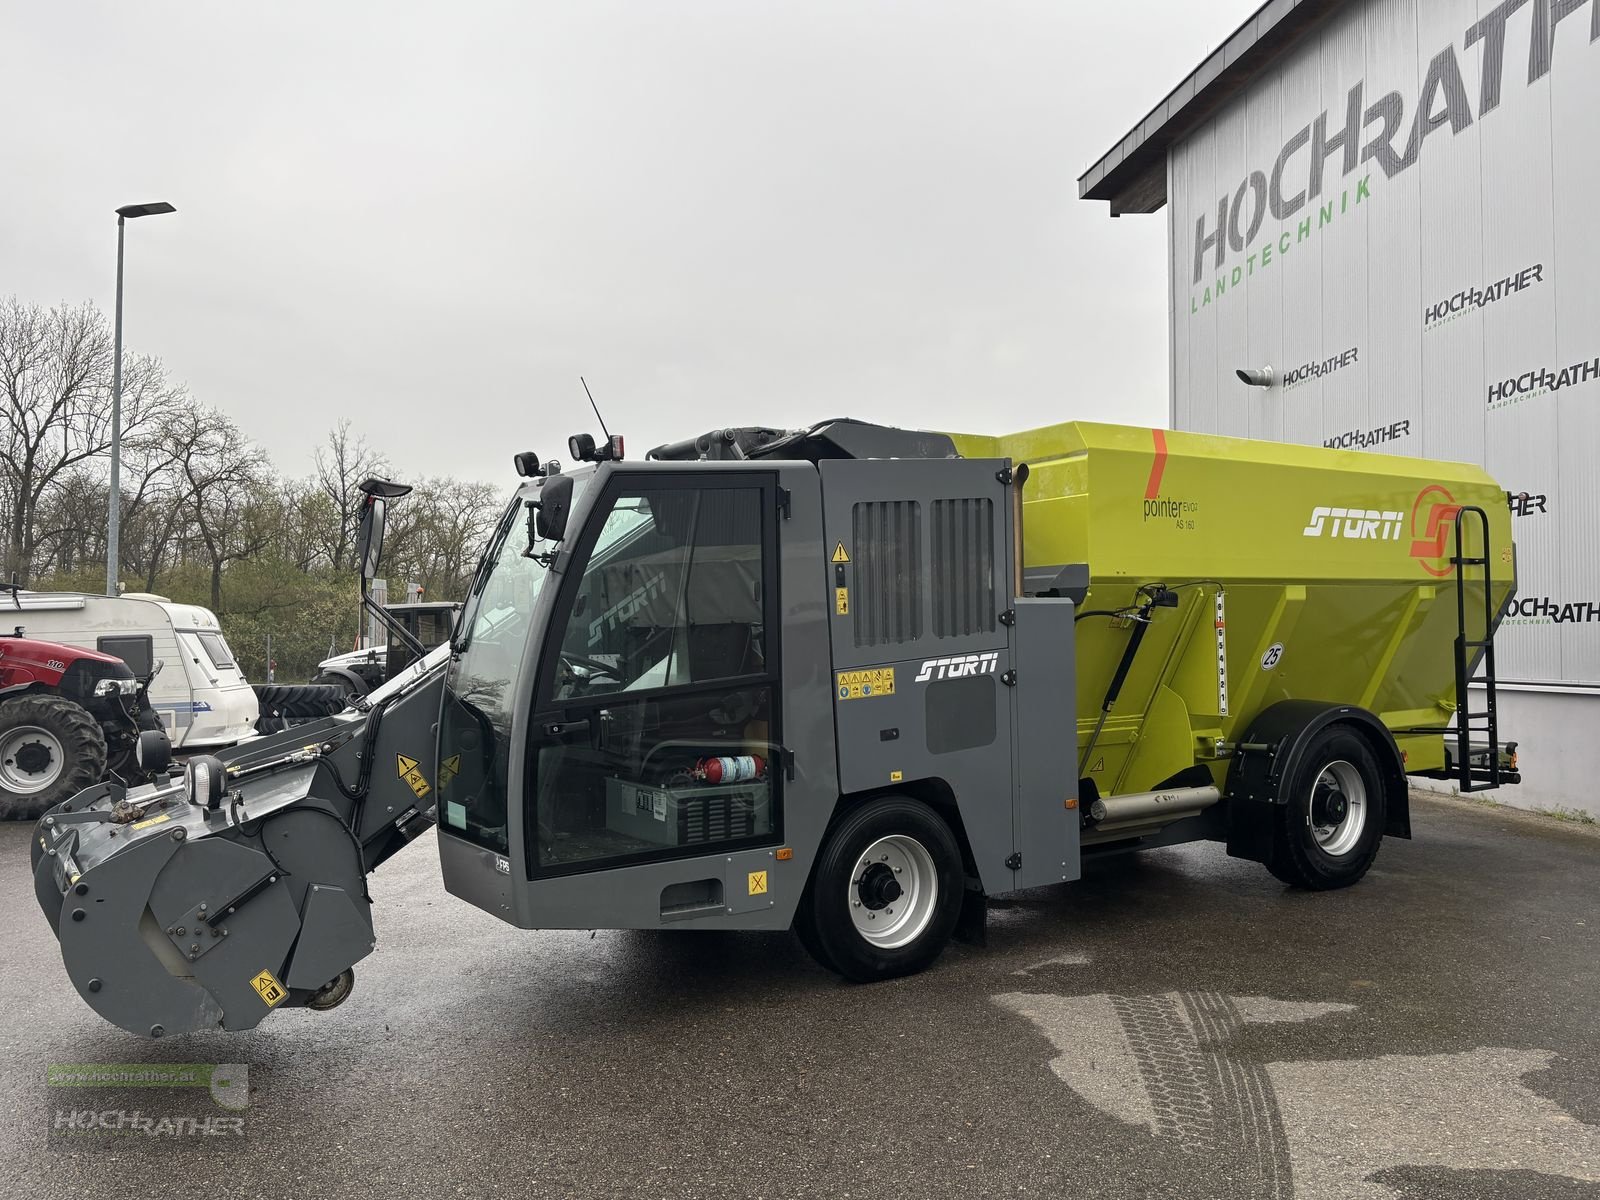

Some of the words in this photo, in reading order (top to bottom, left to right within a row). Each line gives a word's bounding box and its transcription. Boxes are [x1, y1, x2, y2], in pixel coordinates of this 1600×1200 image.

[1191, 174, 1371, 314] LANDTECHNIK
[1424, 263, 1543, 325] HOCHRATHER
[1282, 347, 1358, 388] HOCHRATHER
[1487, 357, 1600, 403] HOCHRATH
[1323, 419, 1410, 449] HOCHRATHER
[1144, 495, 1182, 522] pointer
[1303, 506, 1404, 540] STORTI
[587, 571, 666, 648] STORTI
[1505, 597, 1600, 624] OCHRATH
[915, 652, 999, 683] STORTI
[1263, 647, 1282, 665] 25
